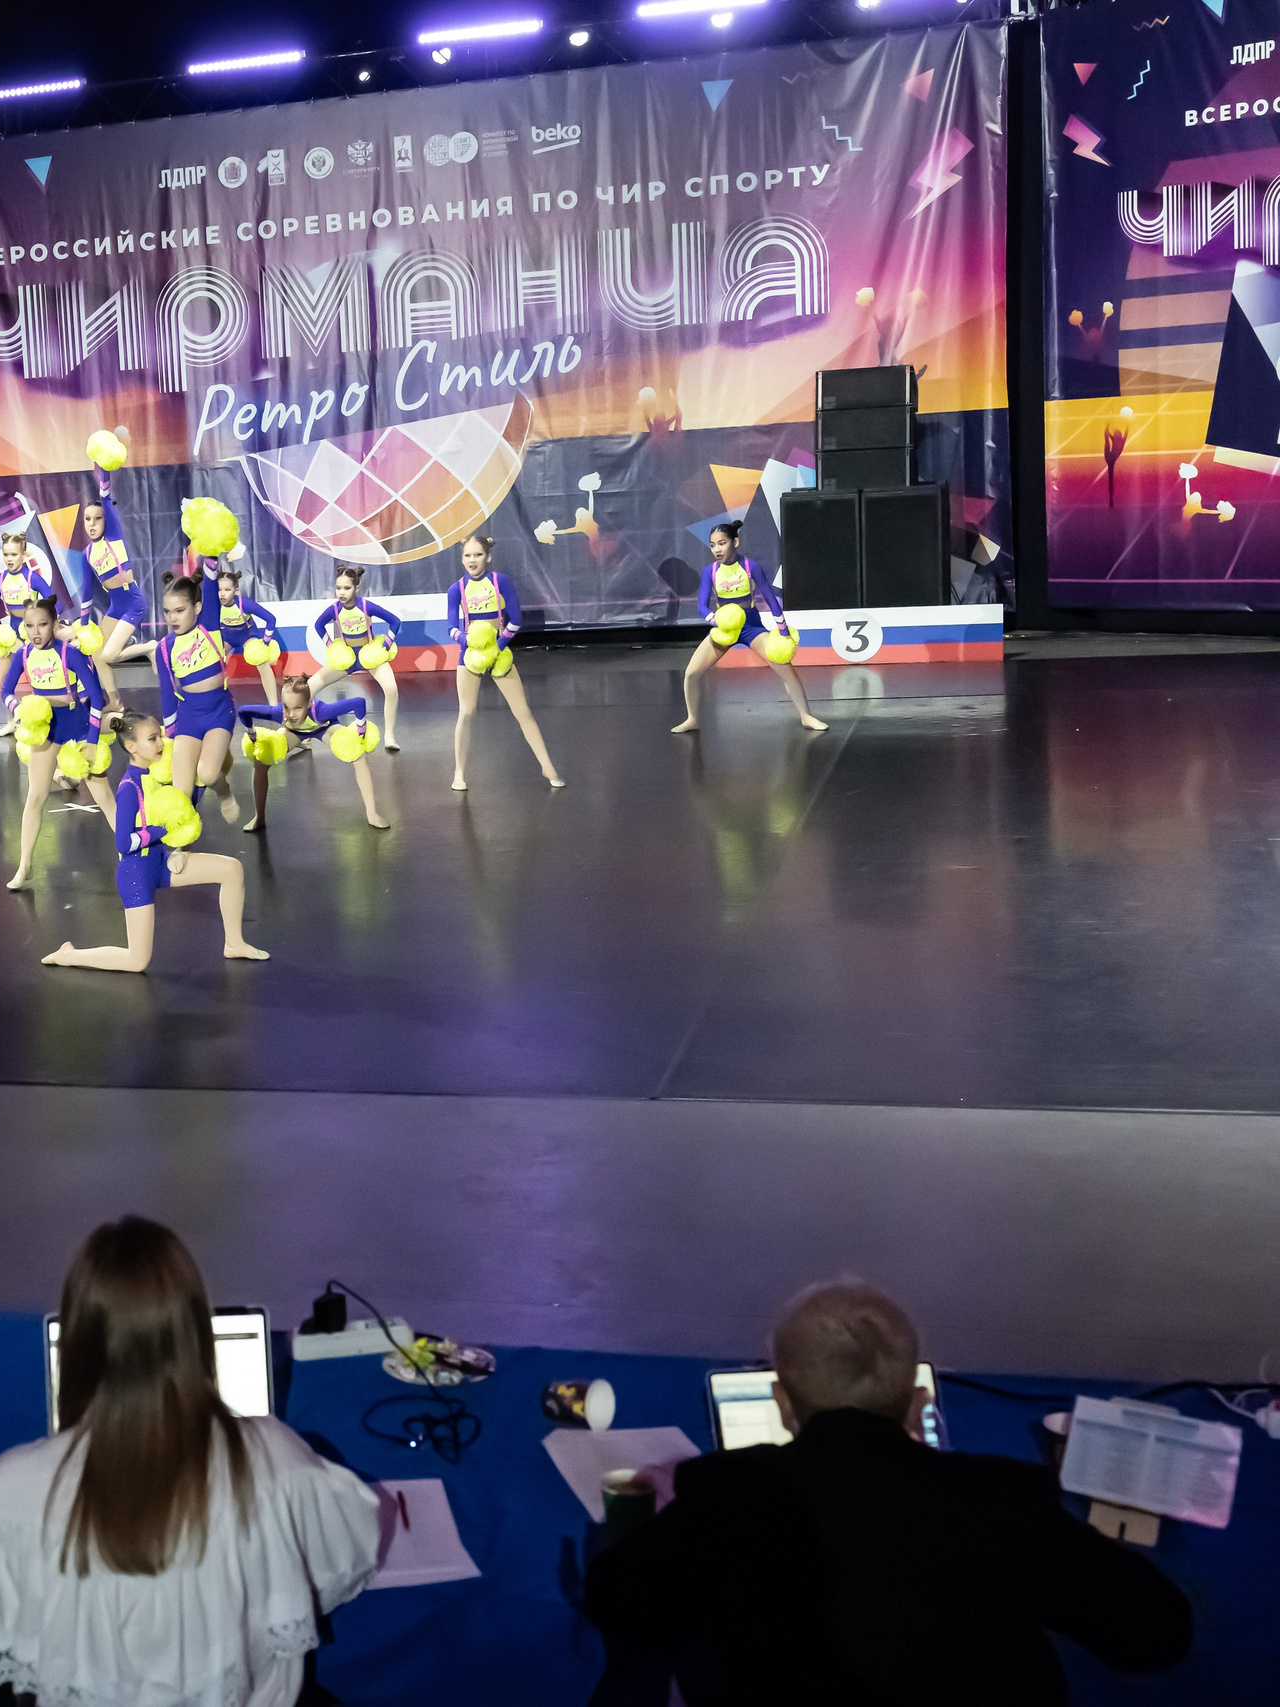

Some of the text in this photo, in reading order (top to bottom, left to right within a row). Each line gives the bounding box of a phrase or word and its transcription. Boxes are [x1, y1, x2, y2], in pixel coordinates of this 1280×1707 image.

[1230, 39, 1276, 66] ЛДПР
[531, 123, 582, 143] beko
[158, 165, 207, 190] ЛДПР
[236, 195, 514, 242] СОРЕВНОВАНИЯ
[532, 189, 578, 213] ПО
[596, 180, 667, 206] ЧИР
[684, 163, 830, 198] СПОРТУ
[193, 335, 582, 456] Ретро Стиль
[845, 620, 869, 653] 3
